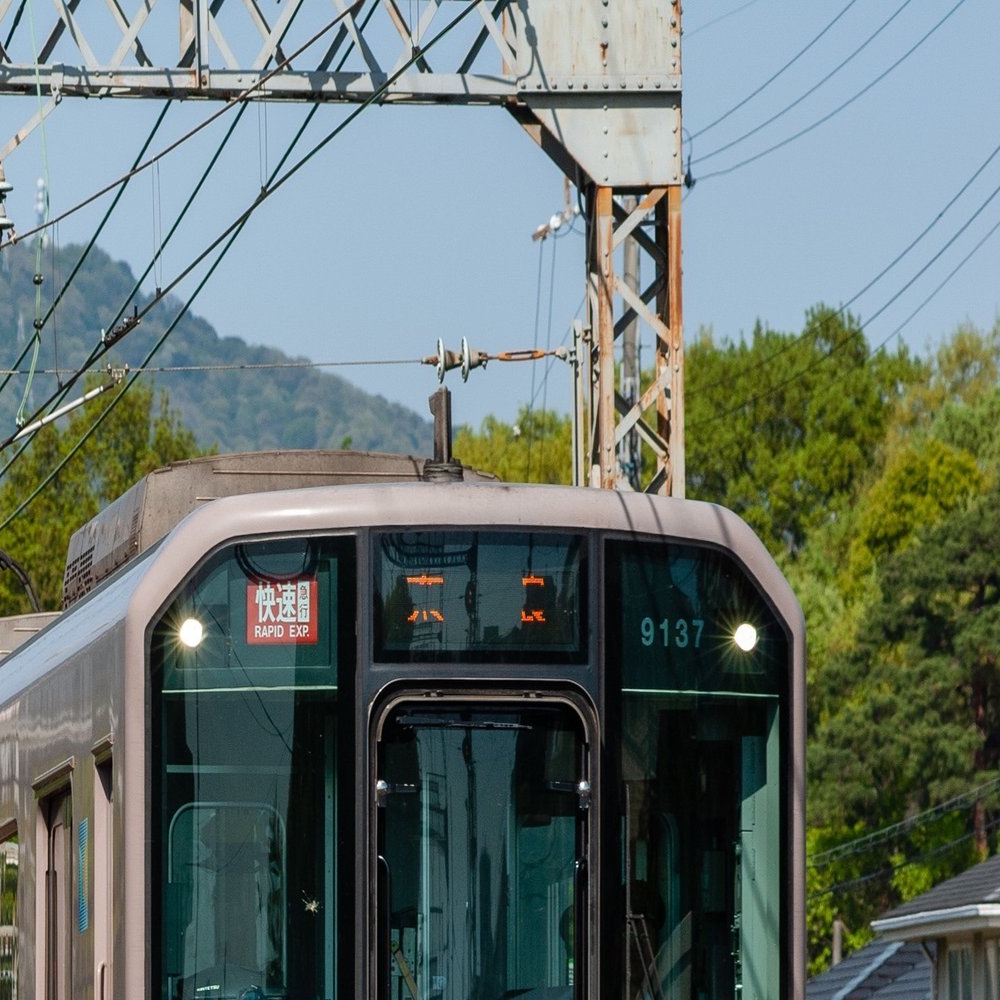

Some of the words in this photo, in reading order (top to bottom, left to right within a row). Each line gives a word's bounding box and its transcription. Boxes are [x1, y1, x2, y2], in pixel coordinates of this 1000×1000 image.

[255, 581, 297, 623] 快速
[299, 585, 308, 619] 急行
[254, 625, 285, 638] RAPID
[289, 625, 310, 638] EXP.
[640, 617, 705, 648] 9137
